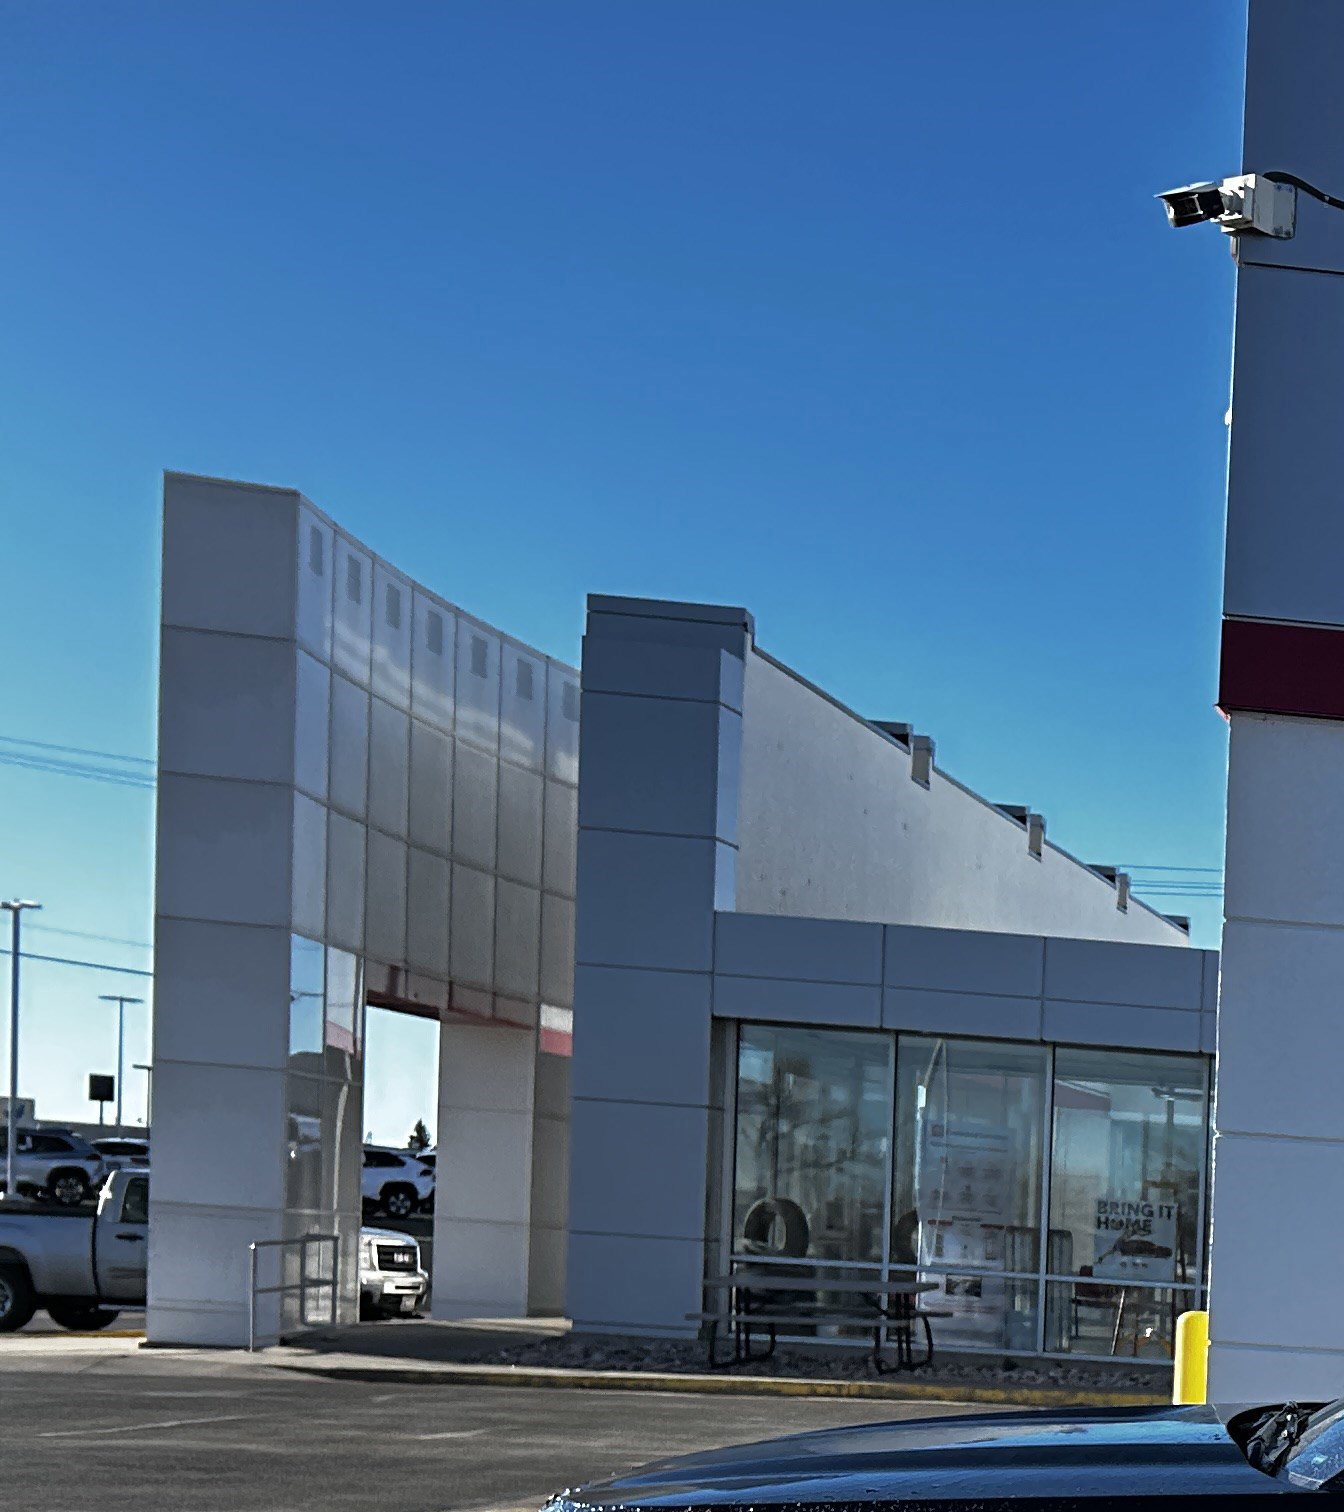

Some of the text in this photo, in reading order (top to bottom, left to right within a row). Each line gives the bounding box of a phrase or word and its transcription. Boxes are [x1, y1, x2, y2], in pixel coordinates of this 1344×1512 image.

[1097, 1200, 1174, 1220] BRING IT
[1096, 1216, 1152, 1234] HOME
